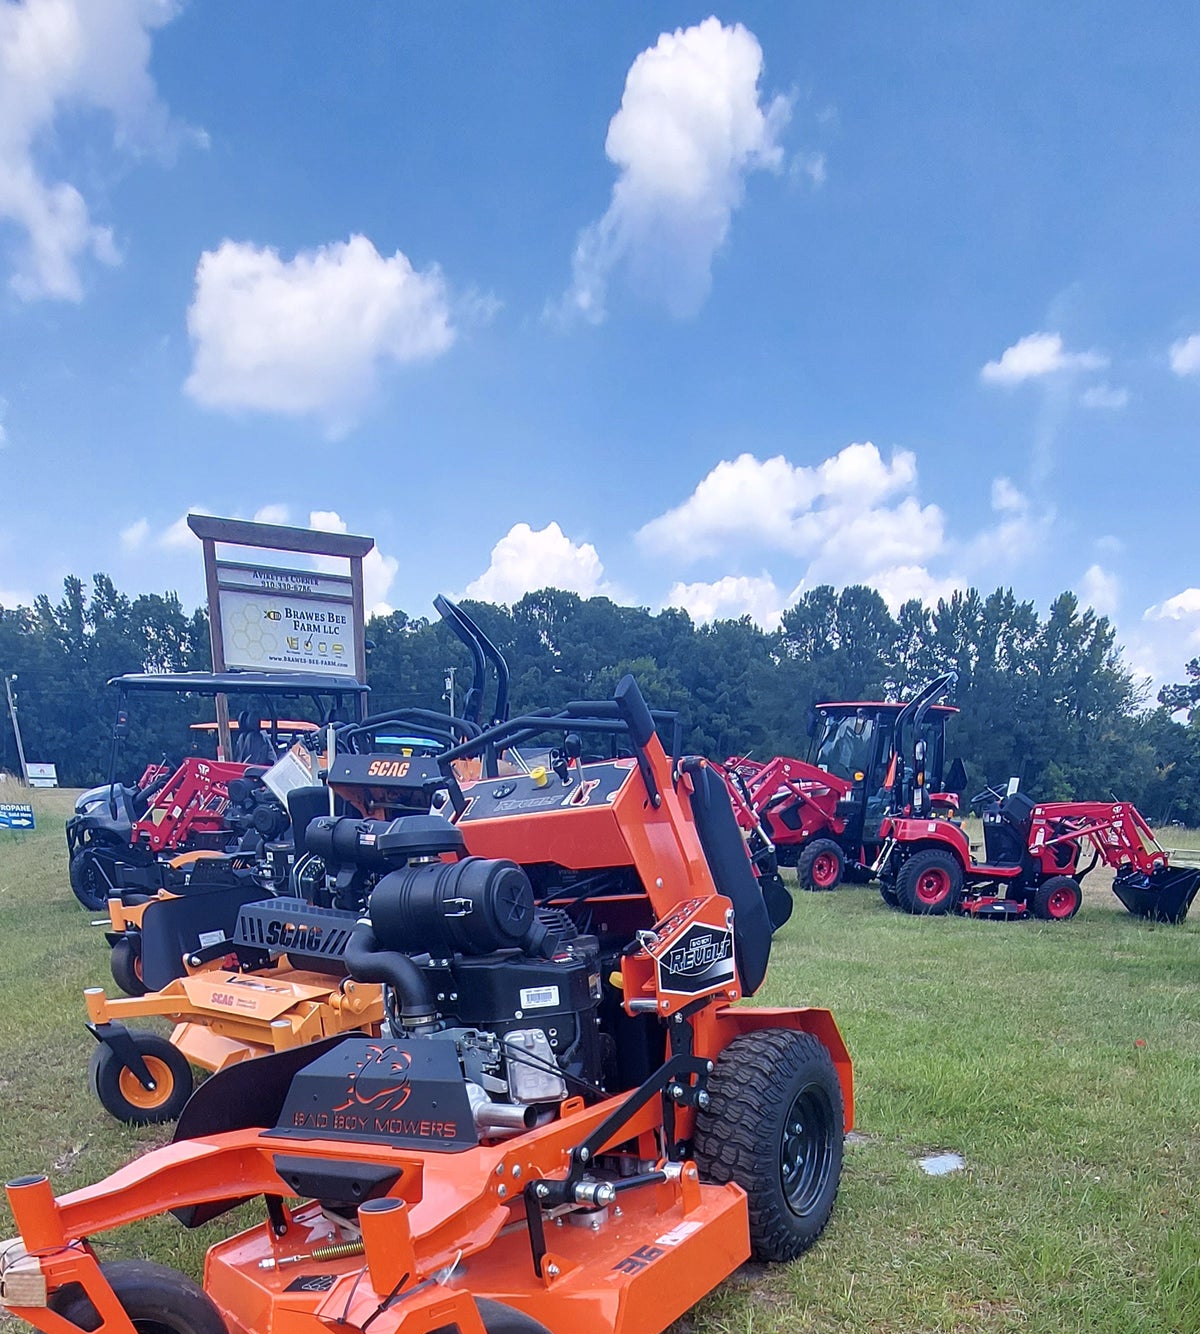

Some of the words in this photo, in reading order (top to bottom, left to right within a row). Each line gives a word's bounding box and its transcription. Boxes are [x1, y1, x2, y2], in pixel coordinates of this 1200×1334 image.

[284, 607, 326, 622] BRAWES
[327, 612, 347, 624] BEE
[293, 620, 321, 633] FARM
[323, 625, 340, 635] LLC
[368, 760, 410, 778] SCAG
[267, 921, 323, 951] SCAG
[670, 940, 730, 974] REVOLT
[211, 993, 234, 1006] SCAG
[293, 1112, 328, 1129] BAD
[333, 1113, 369, 1131] BOY
[374, 1118, 458, 1138] MOWERS
[611, 1244, 667, 1276] 36
